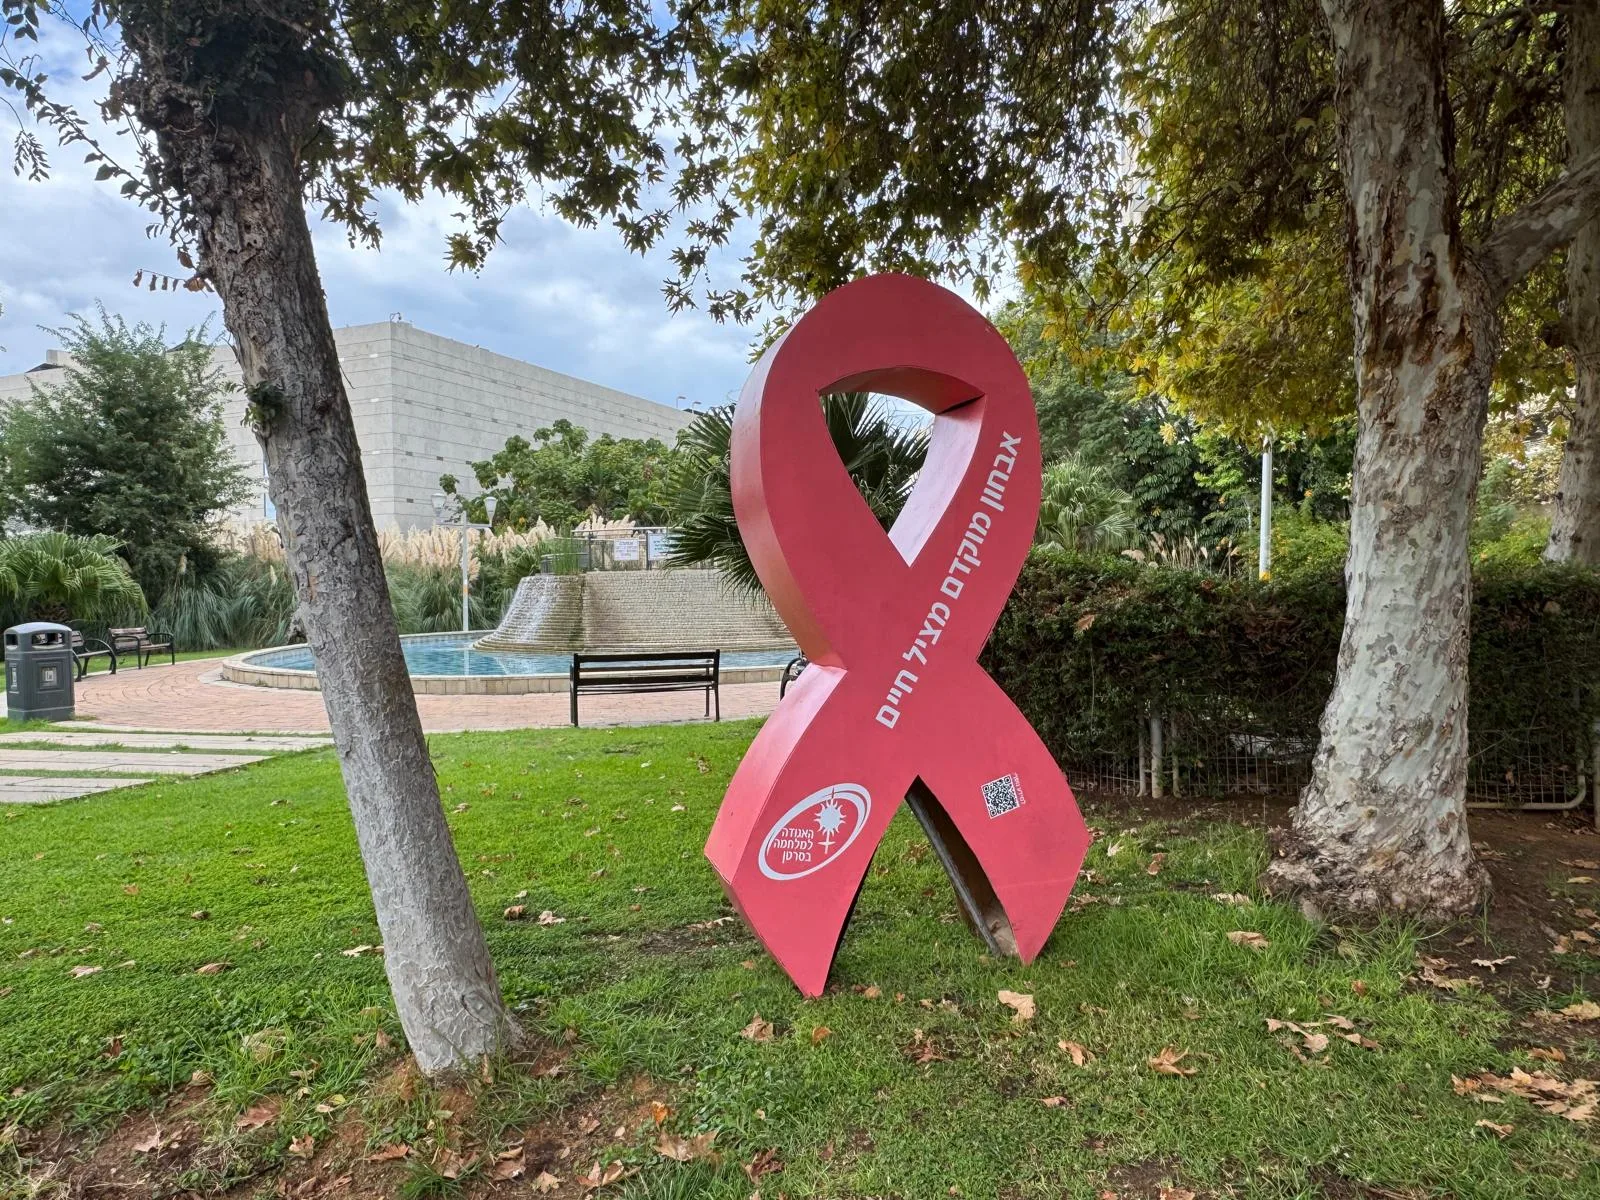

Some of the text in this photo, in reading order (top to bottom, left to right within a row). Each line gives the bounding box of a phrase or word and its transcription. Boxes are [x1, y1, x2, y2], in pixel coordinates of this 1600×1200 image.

[875, 430, 1021, 729] אבחון מוקדם מציל חיים
[781, 828, 814, 839] האגודה
[773, 839, 813, 850] למלחמה
[782, 850, 812, 864] בסרטן
